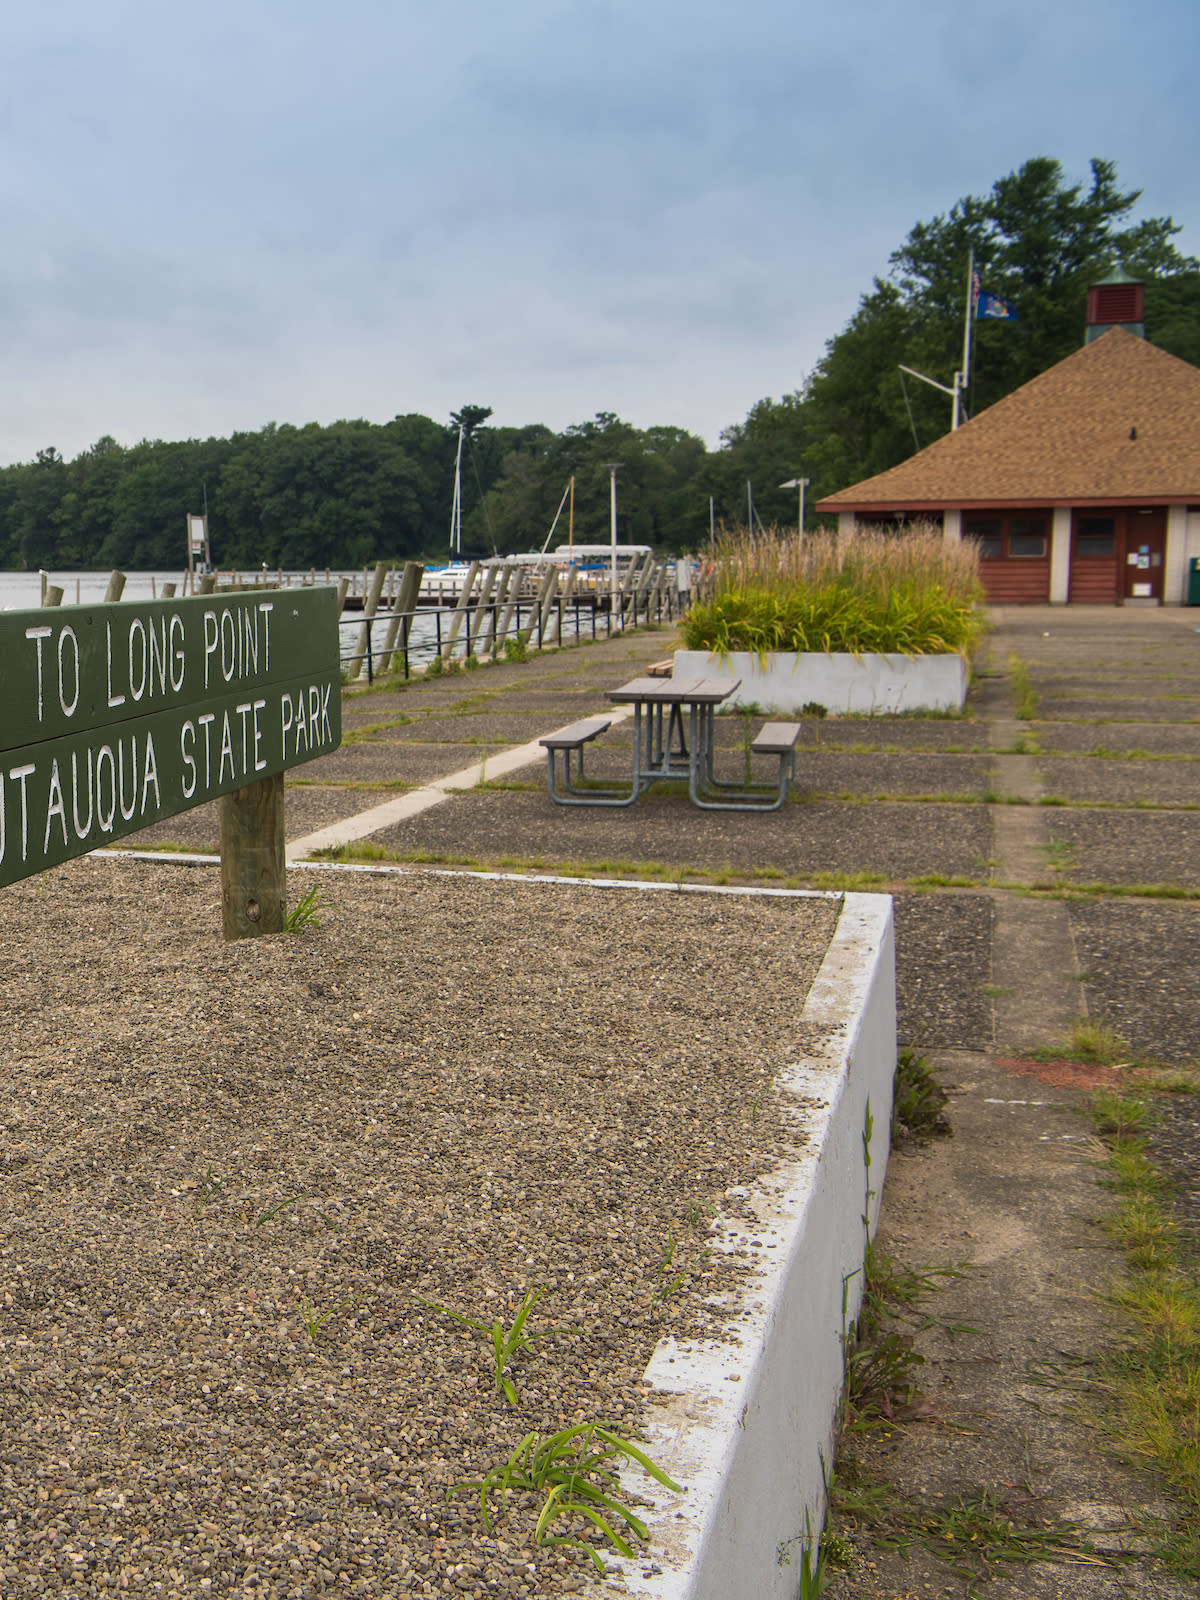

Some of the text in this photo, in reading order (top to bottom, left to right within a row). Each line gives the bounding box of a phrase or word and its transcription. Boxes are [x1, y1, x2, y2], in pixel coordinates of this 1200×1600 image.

[25, 624, 80, 721] TO
[106, 613, 185, 708] LONG
[203, 602, 275, 689] POINT
[181, 698, 267, 798] STATE
[281, 682, 333, 760] PARK
